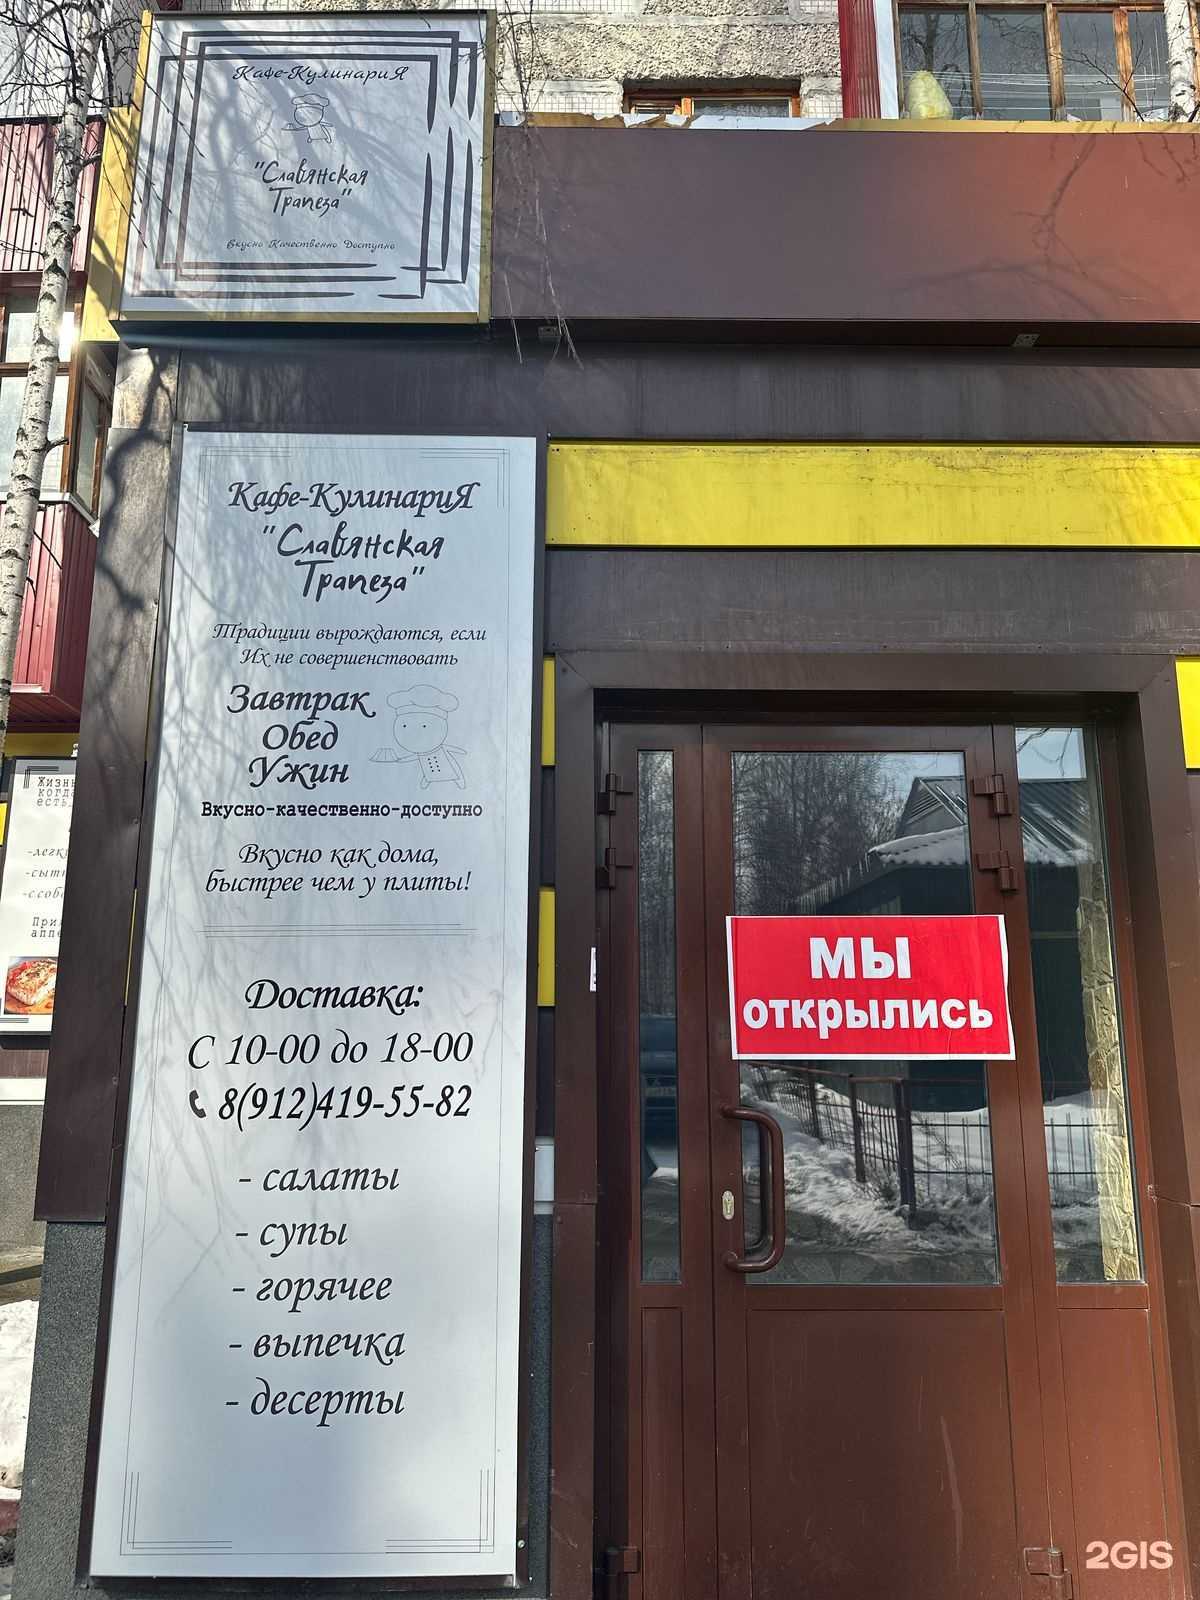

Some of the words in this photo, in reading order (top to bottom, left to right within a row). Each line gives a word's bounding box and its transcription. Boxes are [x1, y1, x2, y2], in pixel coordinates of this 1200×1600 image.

[266, 238, 338, 251] Качественно
[343, 239, 396, 253] Доступно
[228, 482, 480, 518] Кафе-КулинариЯ
[212, 623, 310, 644] Традиции
[316, 624, 443, 645] вырождаются,
[450, 626, 488, 642] если
[240, 648, 271, 668] Их
[274, 651, 294, 666] не
[299, 653, 458, 670] совершенствовать
[227, 684, 376, 722] Завтрак
[263, 720, 338, 750] Обед
[248, 755, 349, 790] Ужин
[201, 802, 482, 819] Вкусно-качественно-доступно
[239, 844, 322, 871] Вкусно
[330, 848, 376, 868] как
[378, 840, 438, 867] дома,
[206, 867, 304, 899] быстрее
[309, 877, 355, 893] чем
[359, 877, 376, 898] у
[384, 872, 471, 891] плиты!
[245, 979, 423, 1016] Доставка:
[742, 999, 994, 1040] открылись
[188, 1035, 215, 1069] С
[225, 1034, 320, 1064] 10-00
[331, 1029, 367, 1063] до
[380, 1032, 473, 1062] 18-00
[219, 1082, 471, 1132] 8(912)419-55-82
[263, 1168, 399, 1191] салаты
[260, 1223, 347, 1258] супы
[256, 1278, 392, 1313] горячее
[254, 1333, 405, 1366] выпечка
[251, 1377, 404, 1427] десерты
